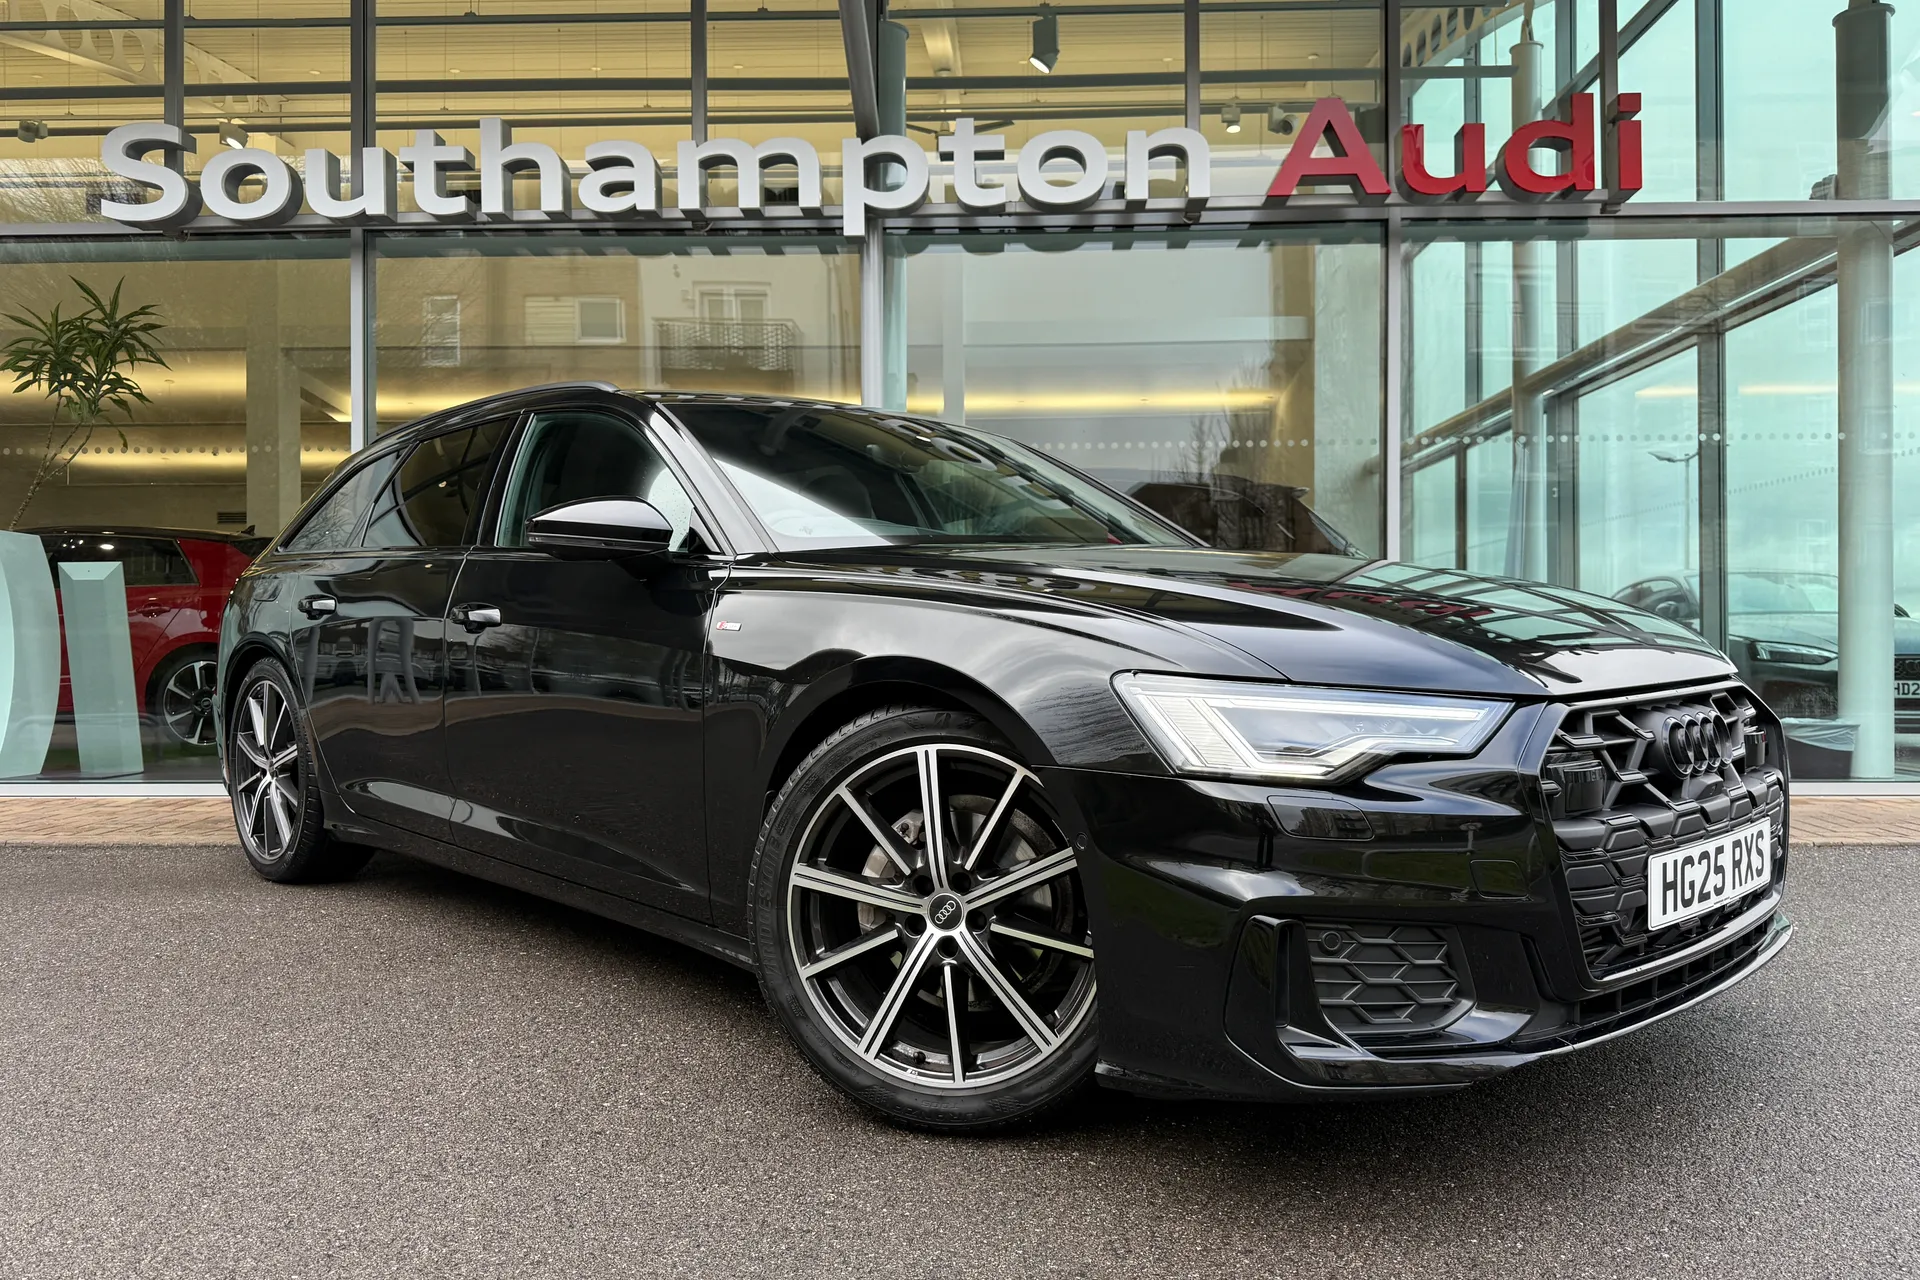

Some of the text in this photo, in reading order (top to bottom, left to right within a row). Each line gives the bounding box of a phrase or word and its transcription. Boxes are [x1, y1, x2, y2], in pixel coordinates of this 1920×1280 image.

[101, 92, 1643, 238] Southampton Audi
[1661, 829, 1765, 916] HG25 RXS
